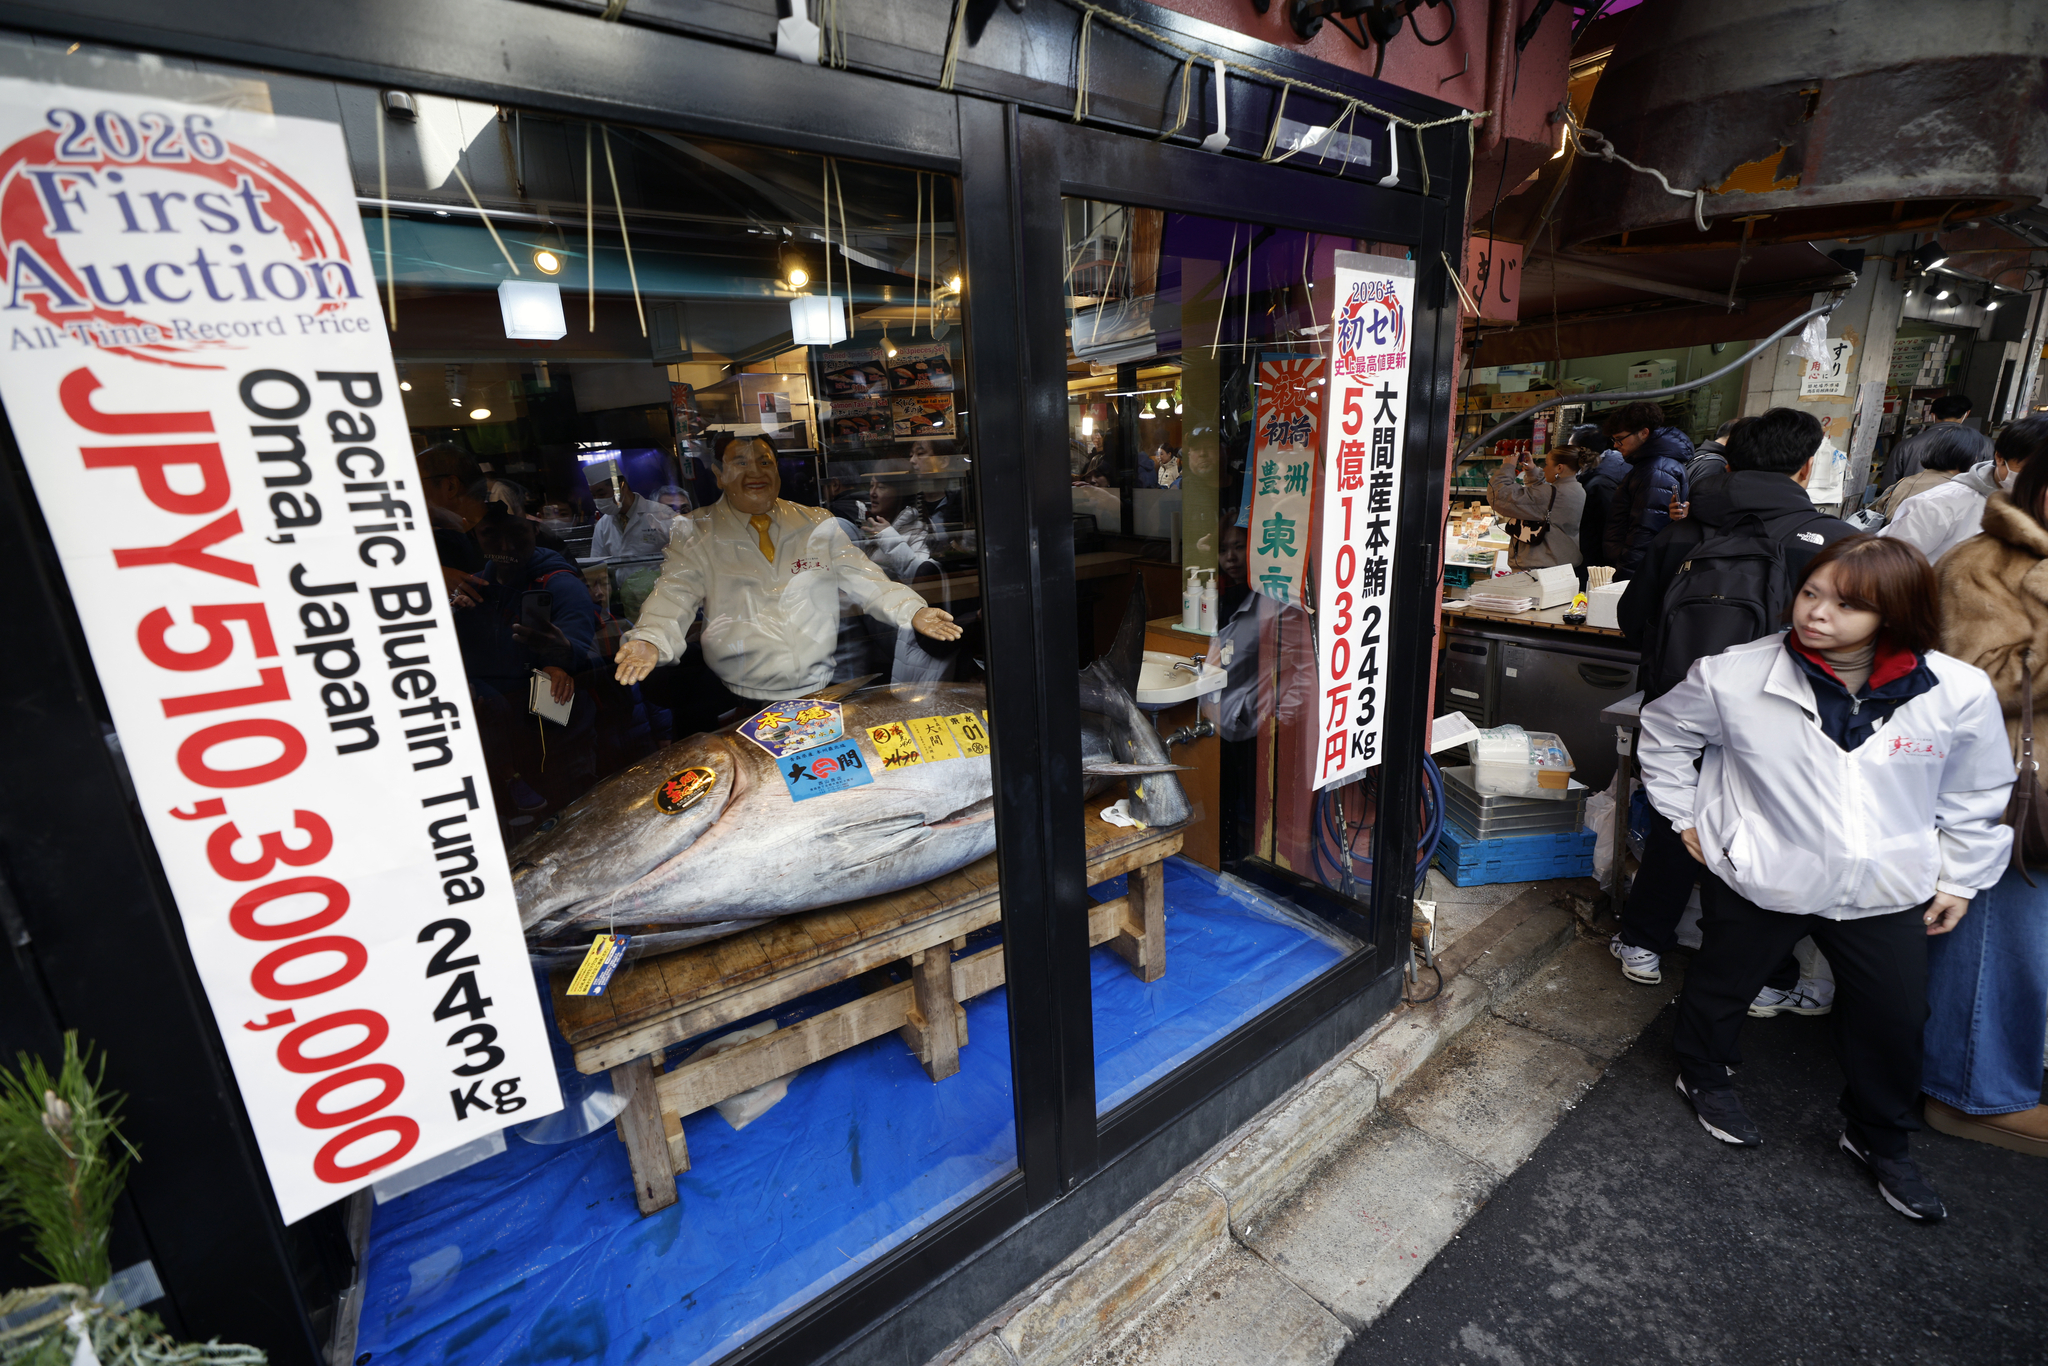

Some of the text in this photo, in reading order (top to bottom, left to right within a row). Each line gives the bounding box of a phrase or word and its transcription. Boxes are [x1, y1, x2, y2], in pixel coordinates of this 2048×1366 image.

[46, 108, 227, 162] 2026
[26, 168, 278, 235] First
[5, 241, 363, 310] Auction
[1352, 279, 1396, 302] 2026年
[1466, 251, 1517, 303] きじ
[9, 312, 371, 352] All-Time Record Price
[1337, 304, 1404, 354] 初セリ
[1334, 352, 1407, 377] 史上最高値更新
[1808, 361, 1821, 380] 用心
[1833, 342, 1848, 378] すり
[1262, 414, 1312, 448] 初荷
[1258, 460, 1309, 498] 豊洲
[1362, 382, 1398, 600] 大間産本鮪
[238, 367, 380, 756] Oma, Japan
[1322, 387, 1364, 780] 5億1030万円
[315, 369, 416, 569] Pacific
[369, 580, 461, 773] Bluefin
[420, 775, 486, 905] Tuna
[925, 723, 943, 746] 大間
[963, 723, 984, 741] 01
[58, 365, 421, 1184] JPY 510,300,000
